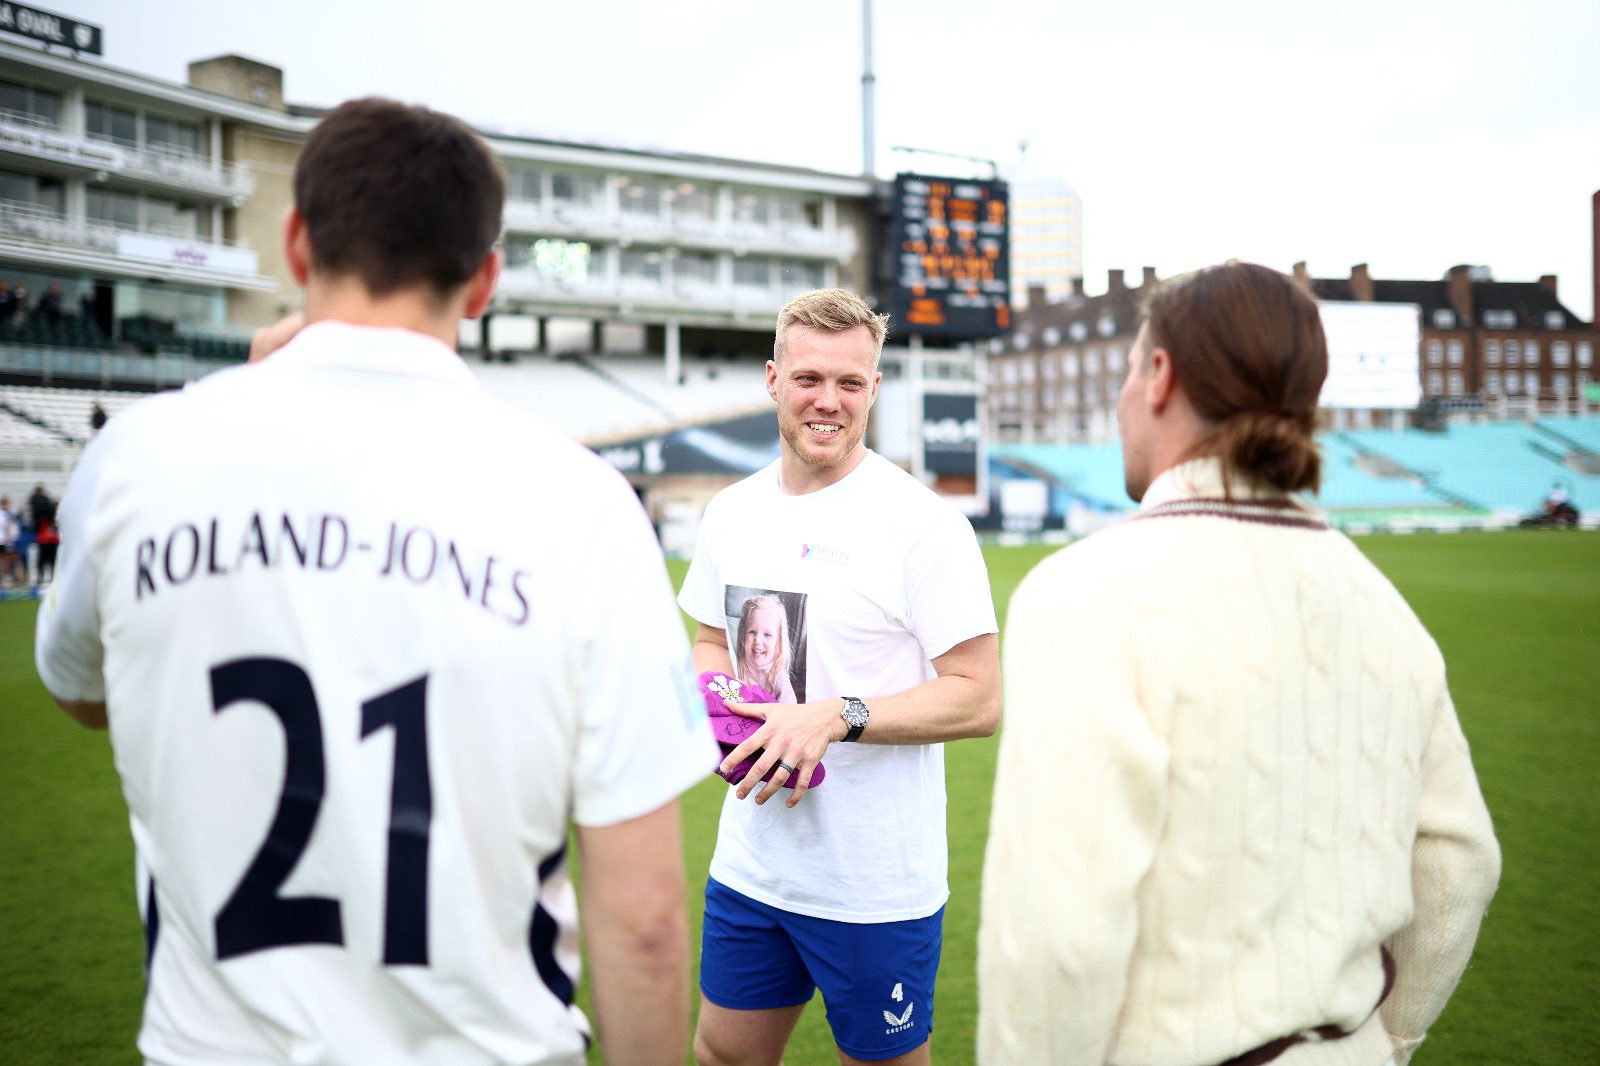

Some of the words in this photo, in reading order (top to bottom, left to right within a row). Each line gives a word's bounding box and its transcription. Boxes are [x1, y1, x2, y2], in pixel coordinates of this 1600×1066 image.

[135, 511, 531, 626] ROLAND-JONES
[209, 656, 434, 968] 21
[891, 982, 904, 1002] 4
[885, 1021, 914, 1035] CASTORE
